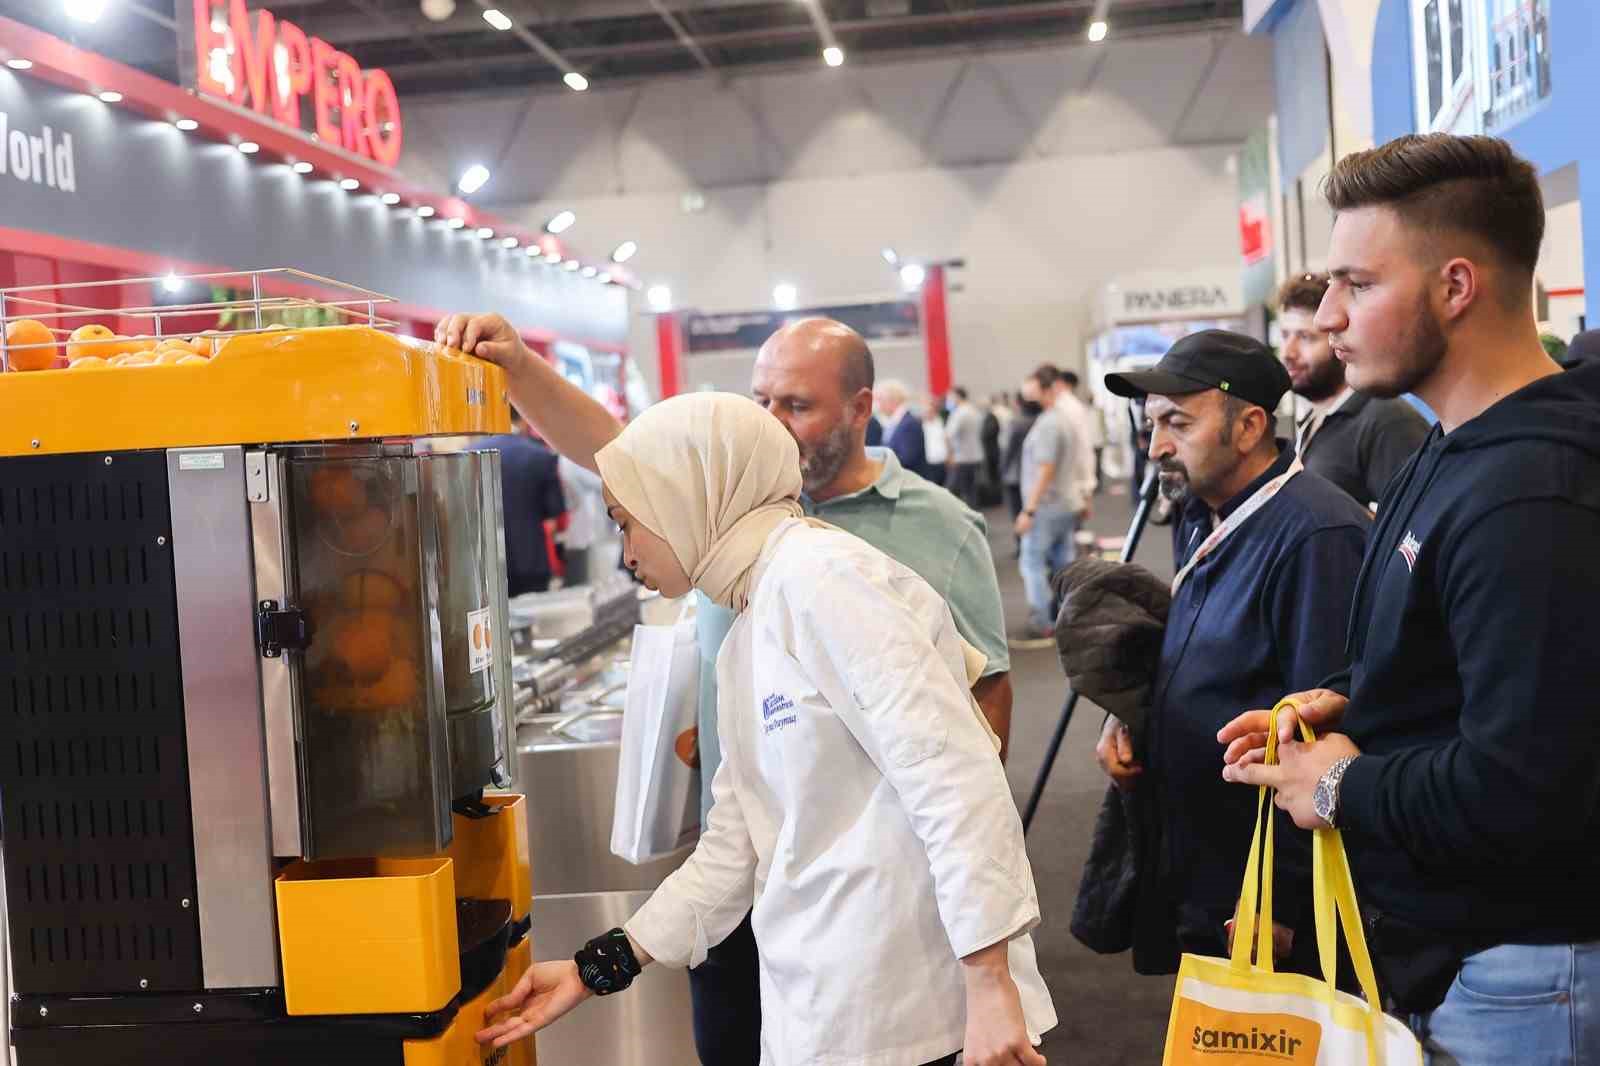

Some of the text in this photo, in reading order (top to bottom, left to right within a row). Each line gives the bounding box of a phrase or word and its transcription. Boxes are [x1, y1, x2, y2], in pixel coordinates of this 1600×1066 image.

[194, 0, 402, 167] EMPERO
[0, 112, 76, 193] orld
[1123, 285, 1229, 312] PANERA
[1192, 1026, 1302, 1056] samixir
